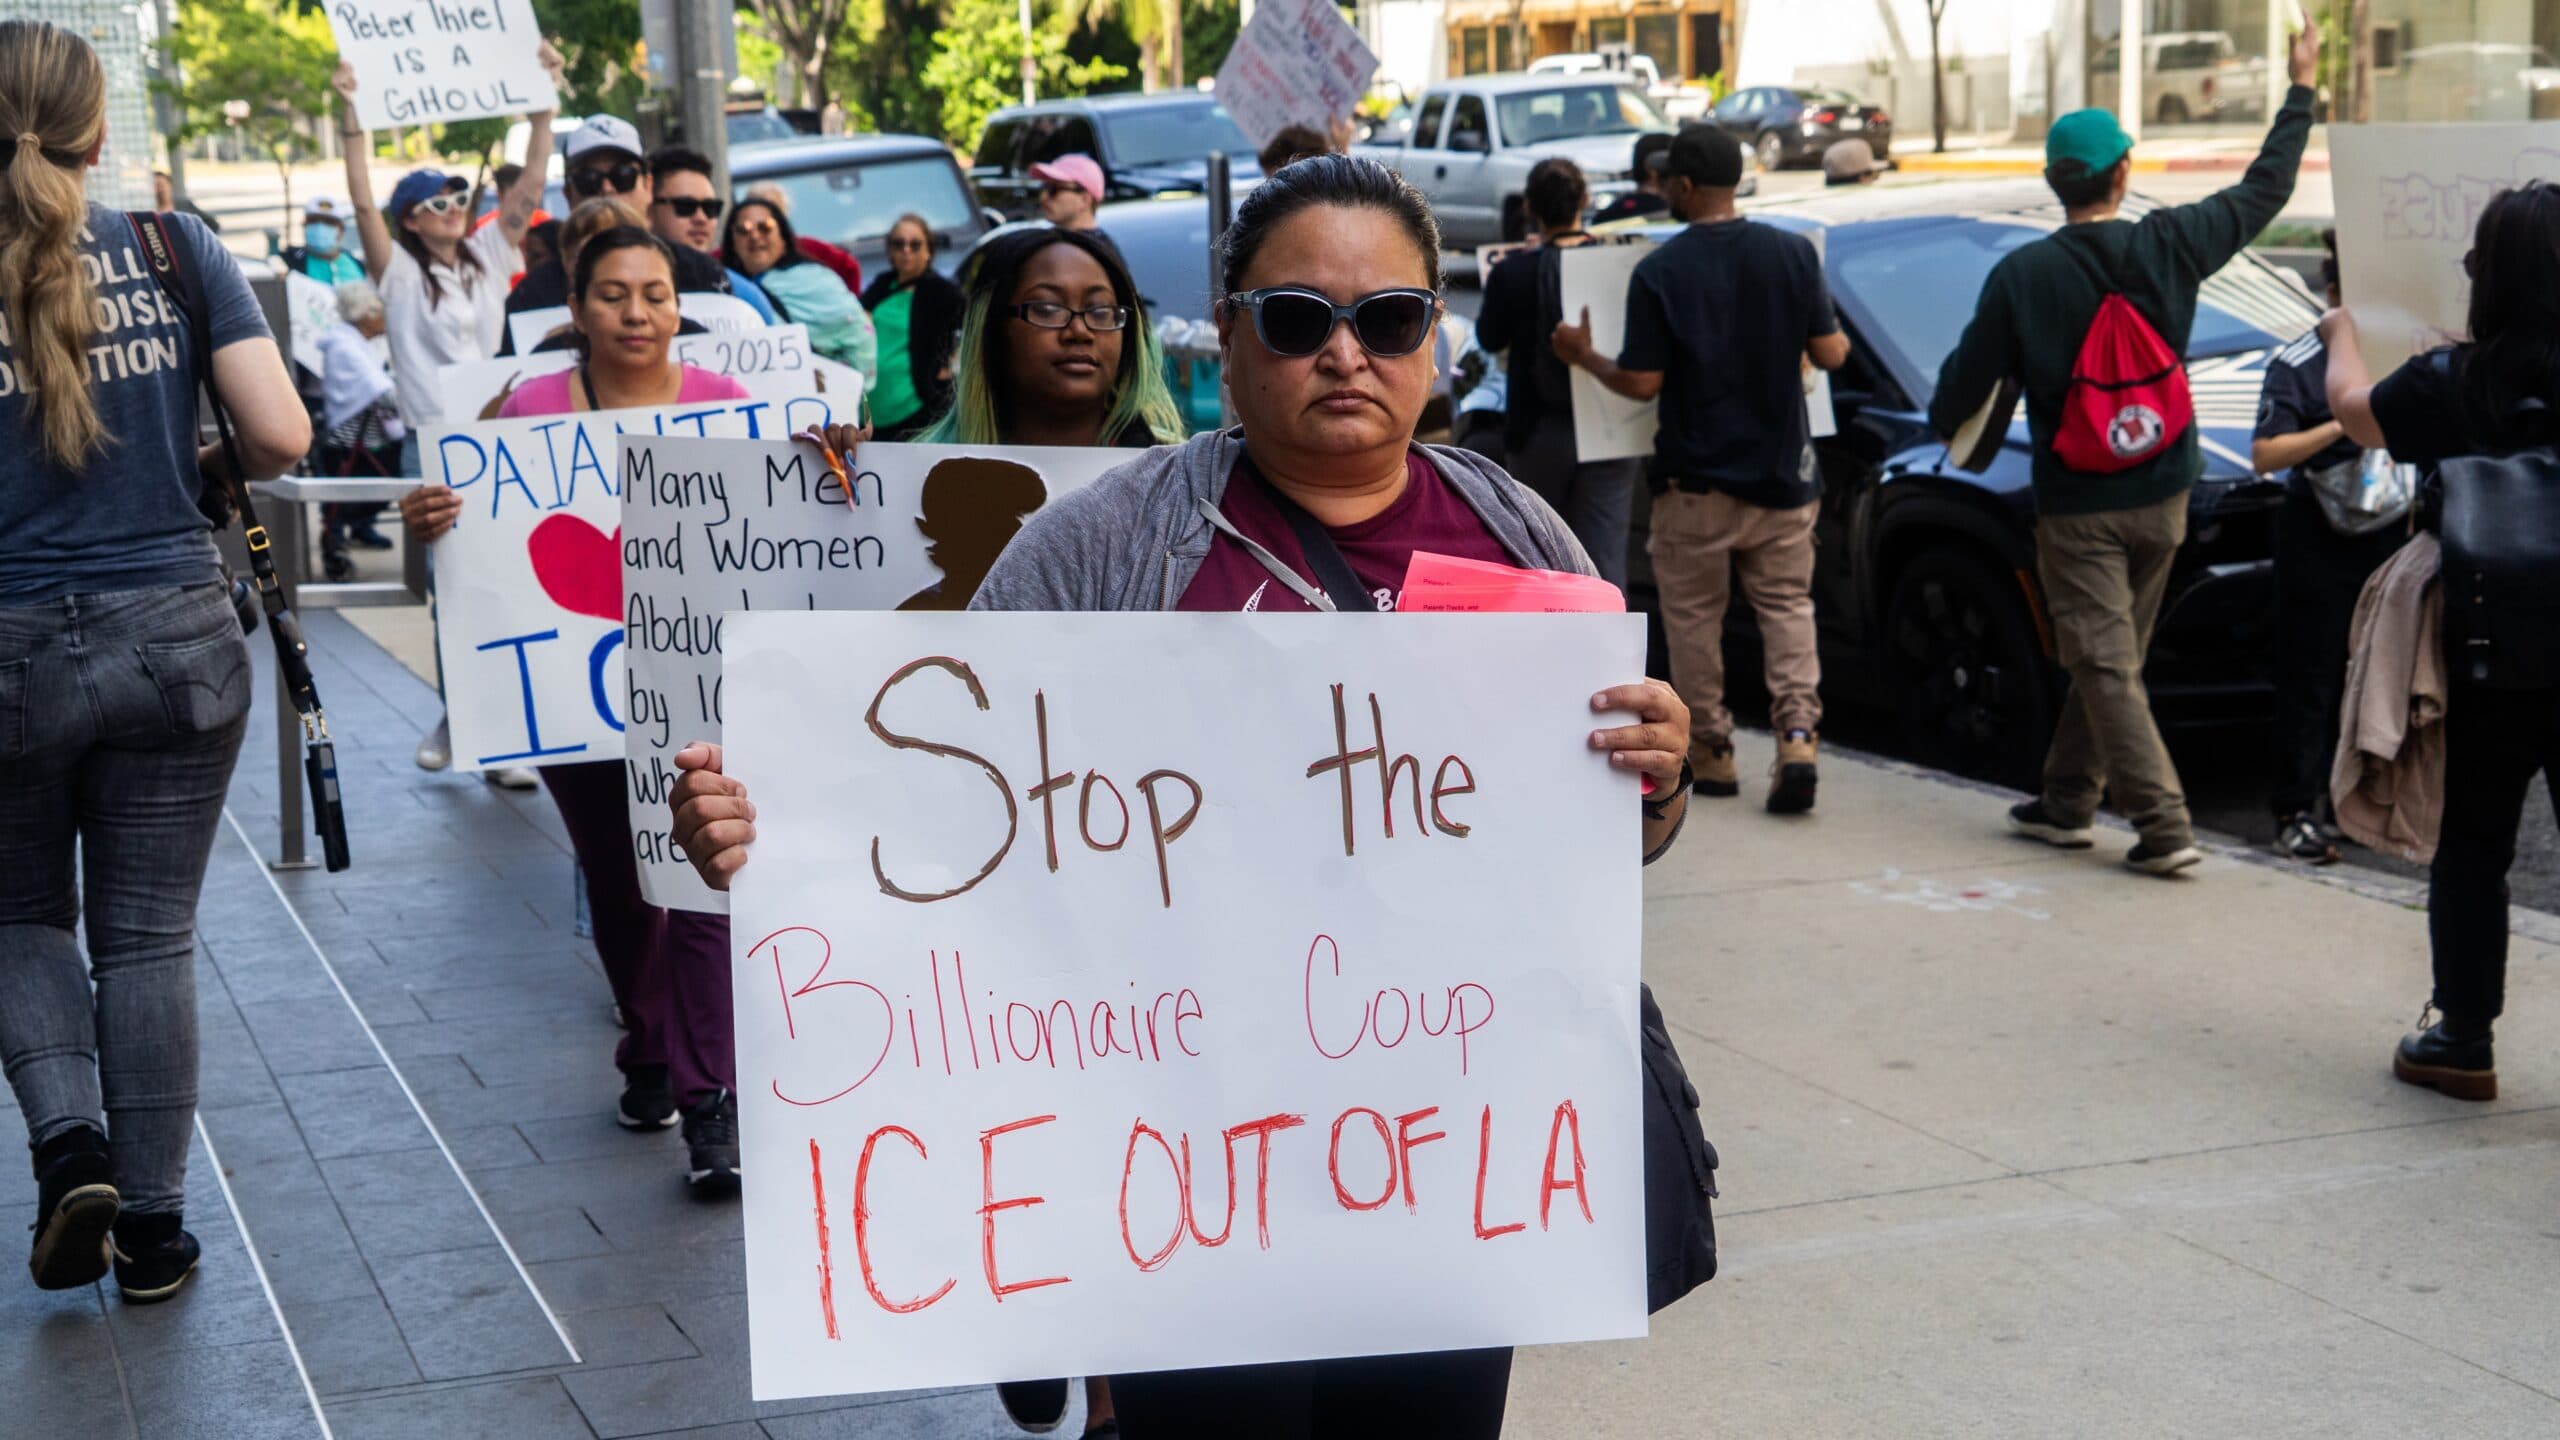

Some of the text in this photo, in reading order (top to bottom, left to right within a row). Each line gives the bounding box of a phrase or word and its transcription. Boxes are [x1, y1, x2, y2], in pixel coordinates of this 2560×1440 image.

[336, 3, 415, 40] Peter
[393, 45, 471, 74] IS A
[384, 80, 530, 121] GHOUL
[78, 246, 149, 287] OLL
[143, 222, 170, 272] Canon
[93, 289, 179, 333] OISE
[715, 335, 803, 375] 2025
[626, 447, 883, 527] Many Men
[624, 517, 884, 575] and Women
[628, 668, 670, 748] by
[864, 656, 1475, 908] Stop the
[747, 926, 1494, 1106] Billionaire Coup
[809, 1099, 1594, 1340] ICE OUT OF LA
